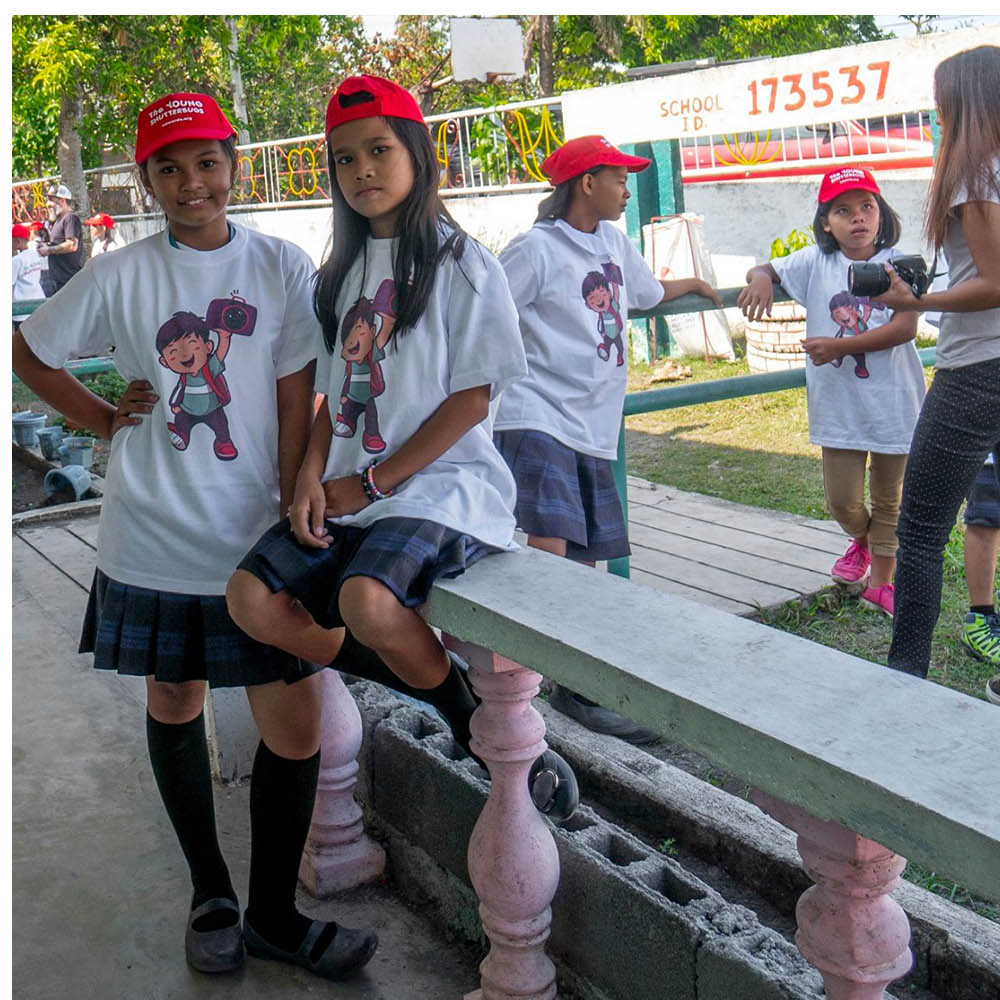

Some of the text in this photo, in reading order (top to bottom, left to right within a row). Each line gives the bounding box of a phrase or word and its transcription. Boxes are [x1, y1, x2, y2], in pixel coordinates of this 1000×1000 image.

[166, 100, 203, 108] YOUNG
[660, 60, 890, 118] SCHOOL 173537
